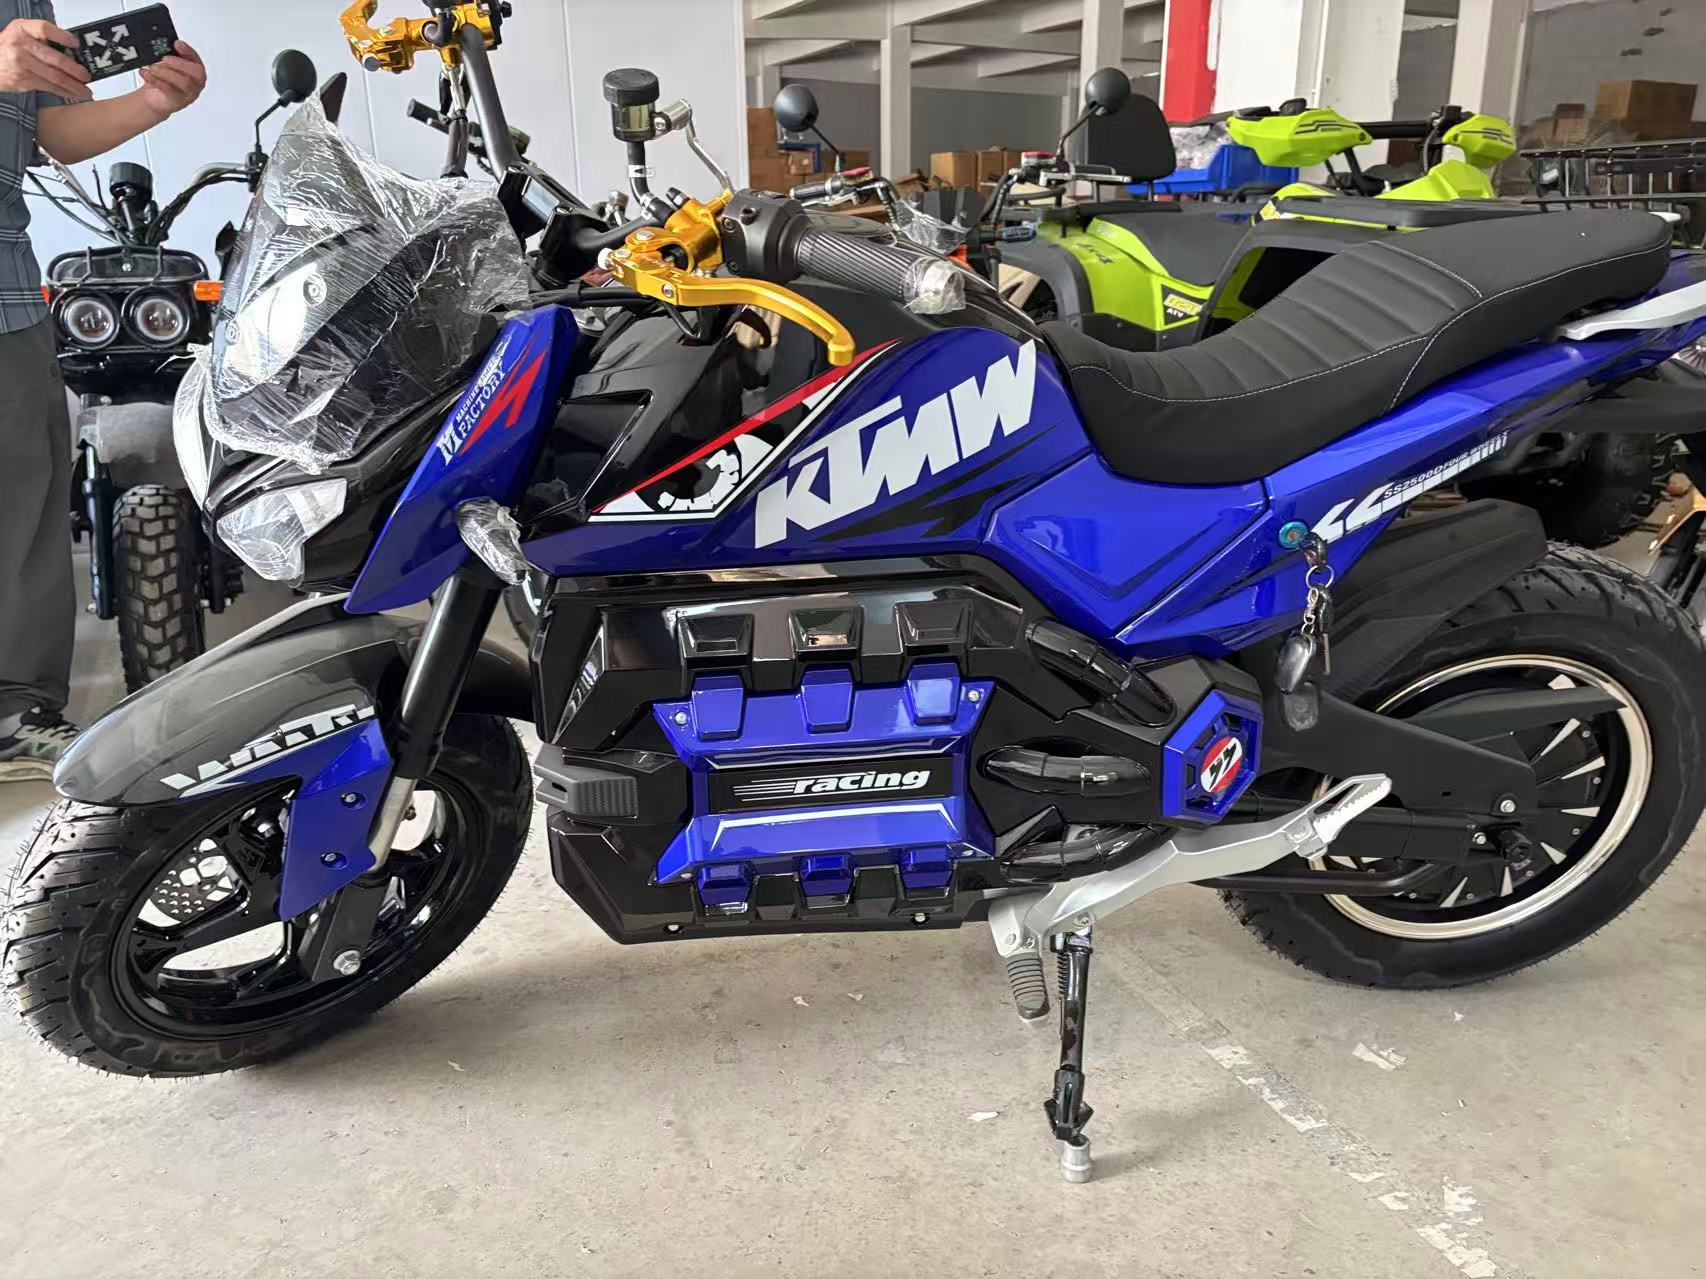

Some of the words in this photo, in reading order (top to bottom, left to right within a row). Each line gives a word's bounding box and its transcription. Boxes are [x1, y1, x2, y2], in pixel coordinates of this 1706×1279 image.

[456, 384, 480, 422] MACHINE
[458, 358, 506, 439] FACTORY
[755, 338, 1037, 549] KTMW
[793, 770, 931, 795] racing
